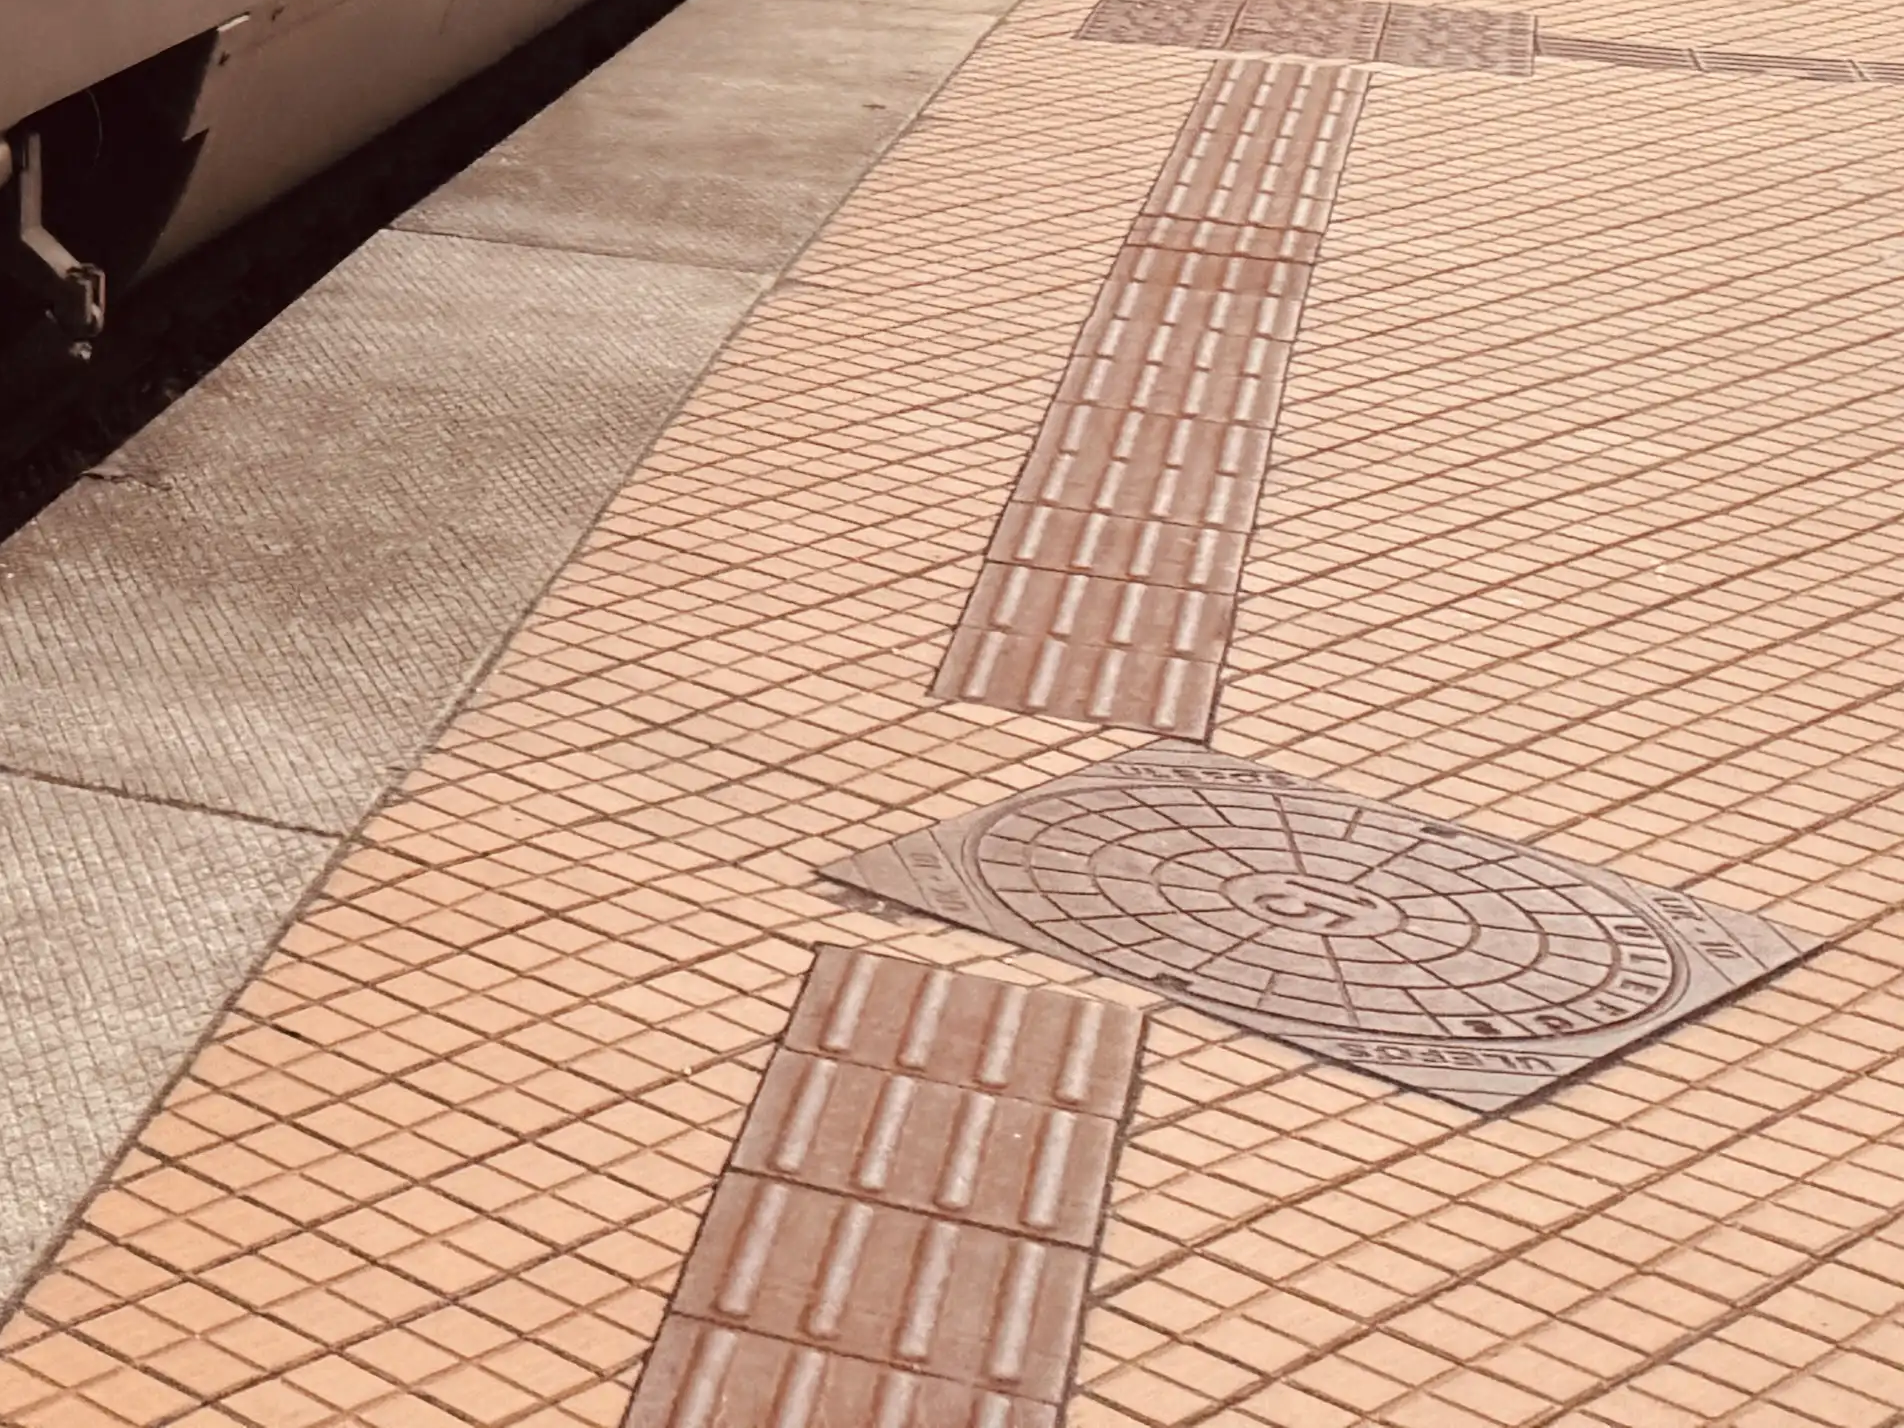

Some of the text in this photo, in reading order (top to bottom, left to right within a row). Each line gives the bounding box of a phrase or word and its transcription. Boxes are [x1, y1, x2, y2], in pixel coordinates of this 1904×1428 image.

[1112, 764, 1297, 787] ULEFOS
[1252, 880, 1378, 929] 15
[1339, 1043, 1558, 1072] ULEFOS
